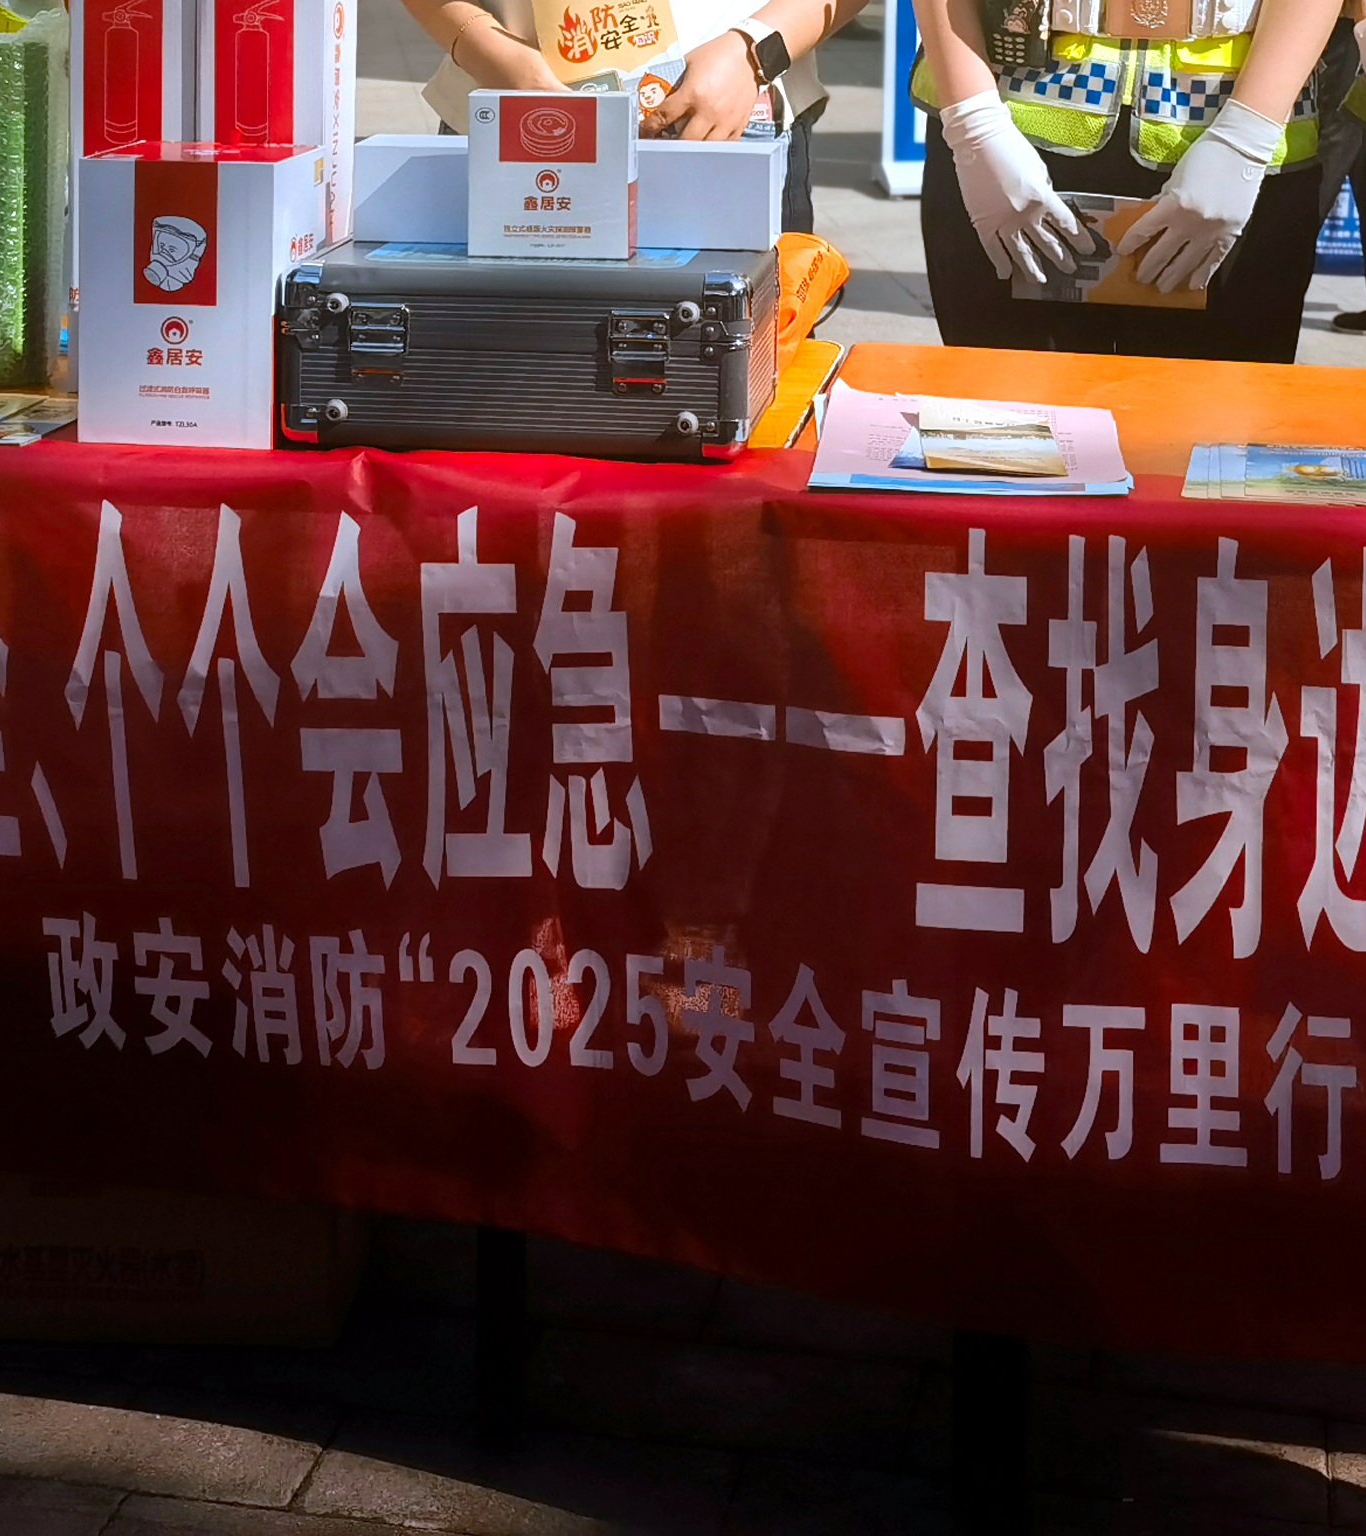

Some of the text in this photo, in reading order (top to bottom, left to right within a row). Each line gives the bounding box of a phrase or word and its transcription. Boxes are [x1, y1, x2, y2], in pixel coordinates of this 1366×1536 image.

[523, 196, 571, 211] 鑫居安
[147, 347, 203, 366] 鑫居安
